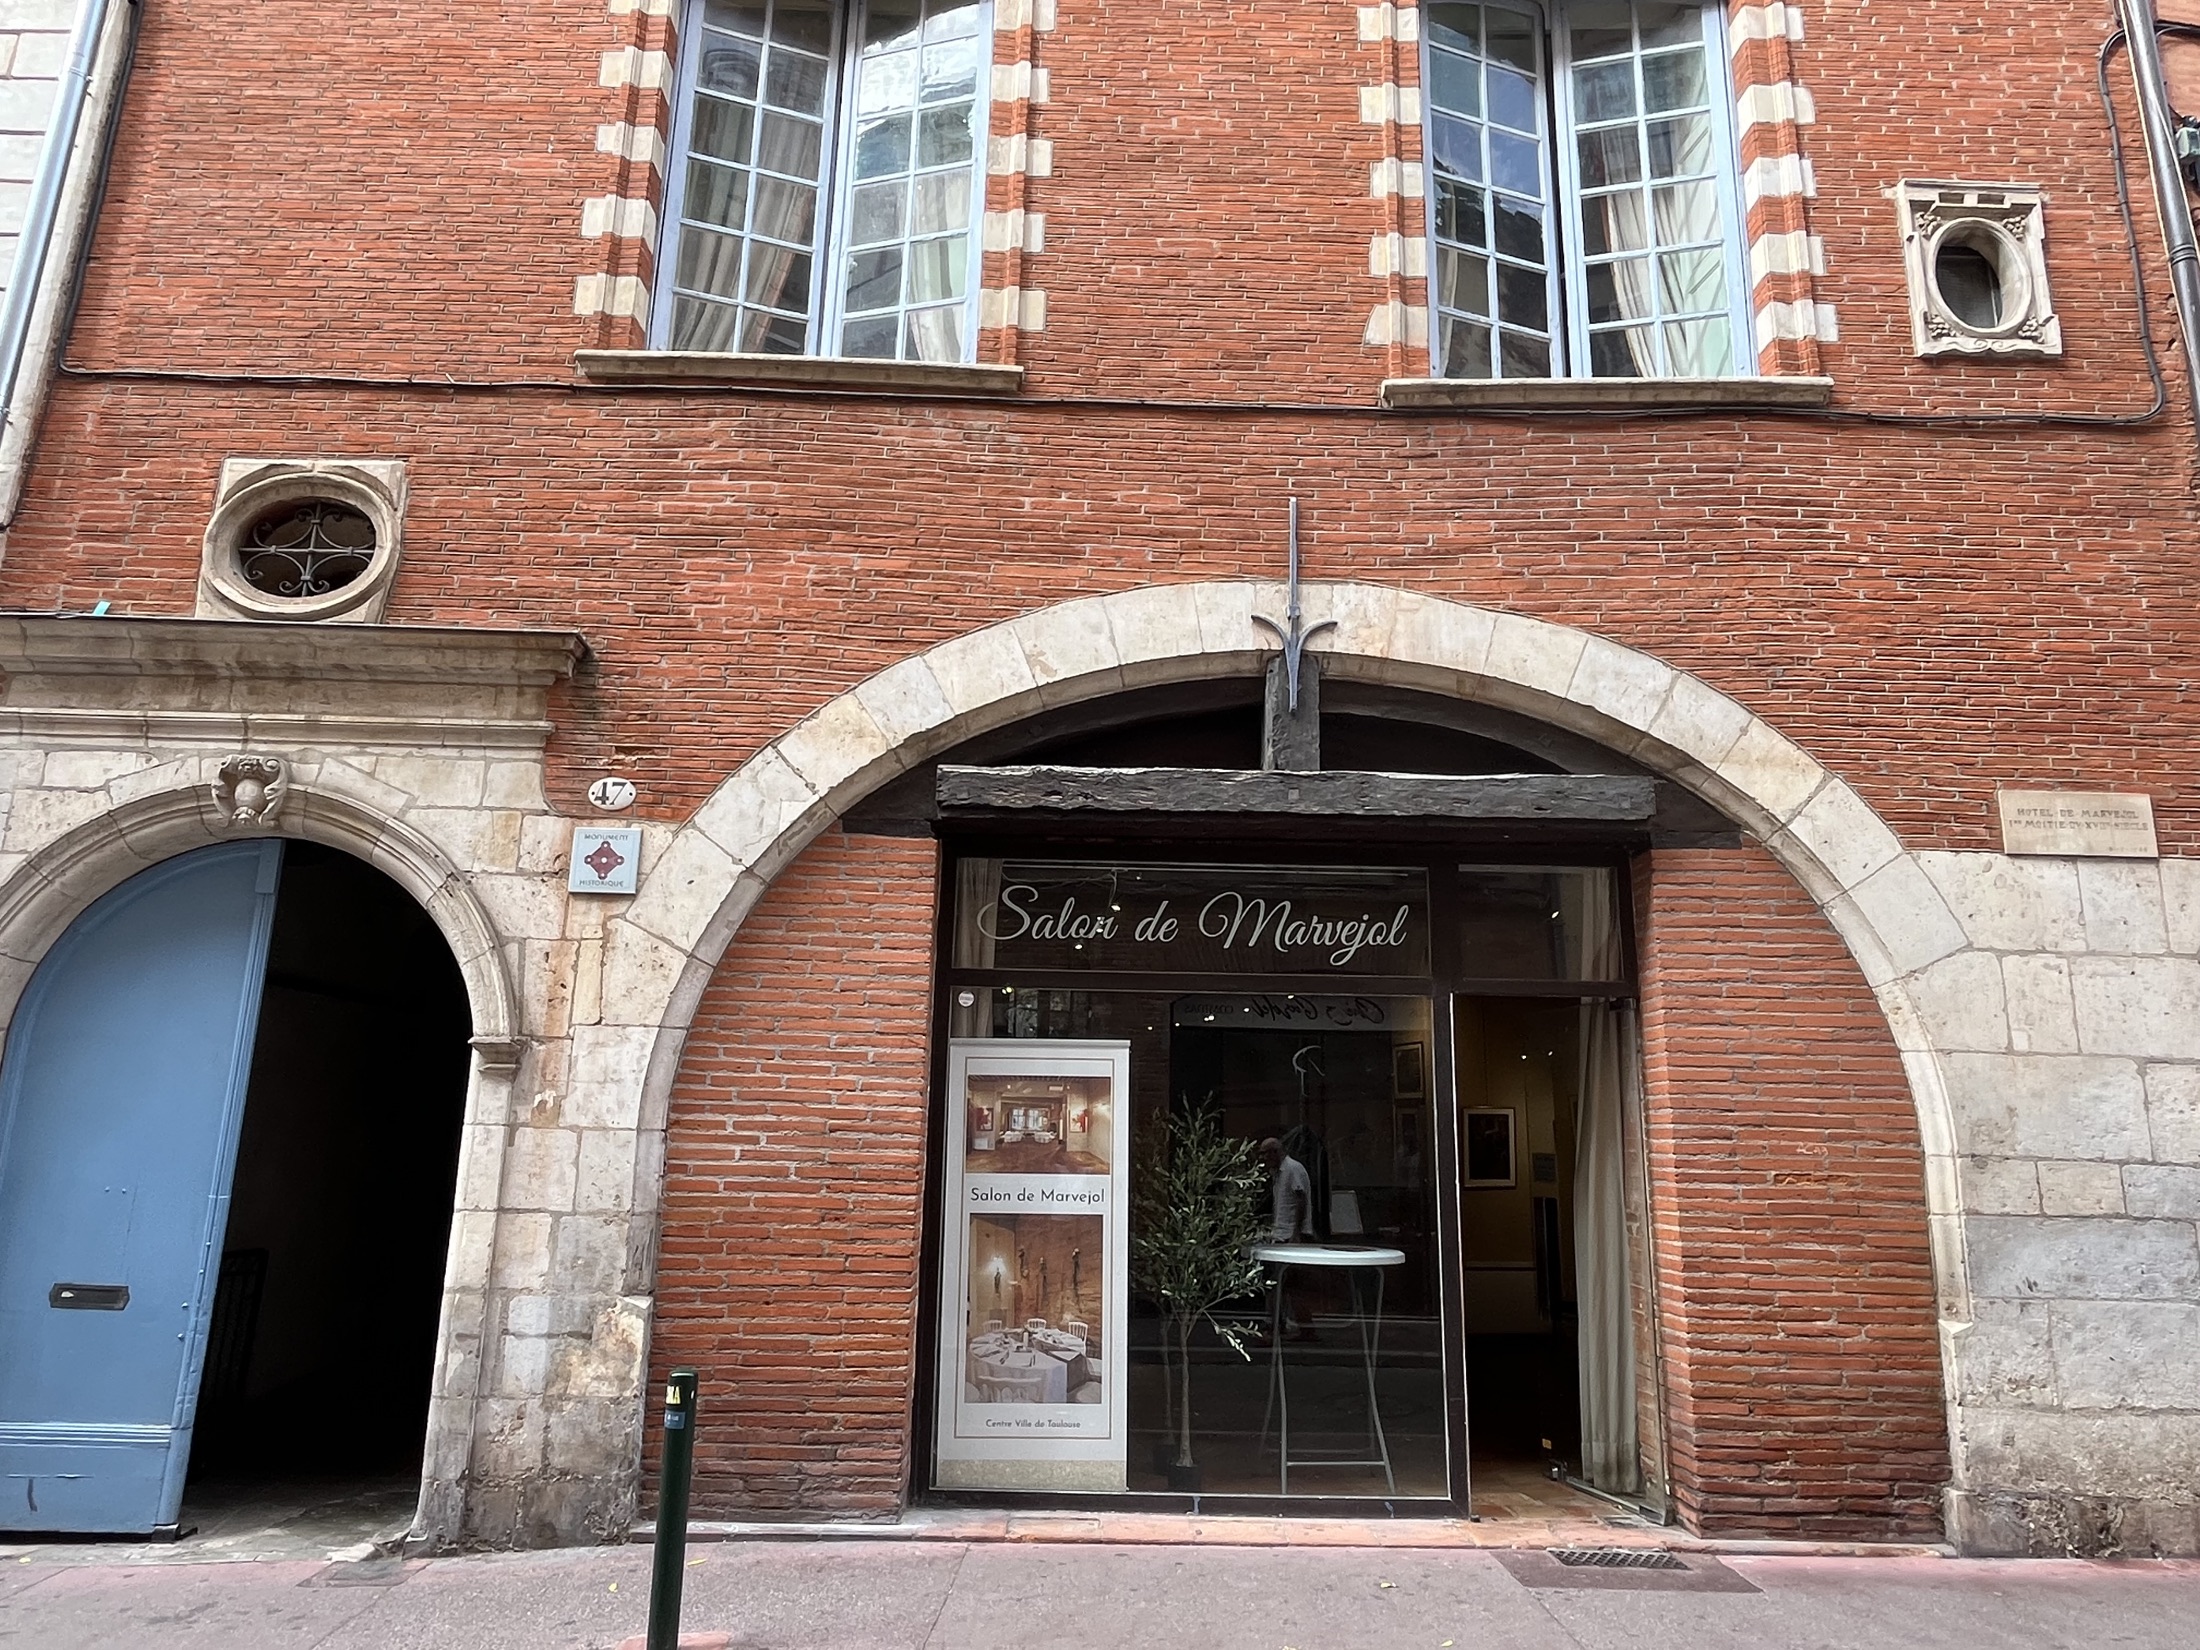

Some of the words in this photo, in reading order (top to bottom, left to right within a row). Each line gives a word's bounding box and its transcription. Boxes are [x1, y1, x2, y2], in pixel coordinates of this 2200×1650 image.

[594, 781, 627, 806] 47
[2017, 808, 2054, 817] HOTEL
[2060, 809, 2074, 818] DE
[2081, 809, 2139, 819] MARVEJOL
[584, 833, 629, 841] MONUMENT
[579, 880, 624, 888] HISTORIQUE
[977, 885, 1118, 940] Salon
[1135, 900, 1179, 943] de
[1198, 891, 1410, 966] Marvejol
[970, 1187, 1011, 1202] Salon
[1017, 1187, 1035, 1202] de
[1041, 1188, 1105, 1205] Marvejol
[985, 1418, 1012, 1428] Centre
[1015, 1419, 1032, 1428] Ville
[1034, 1419, 1046, 1428] de
[1047, 1419, 1081, 1429] Toulouse
